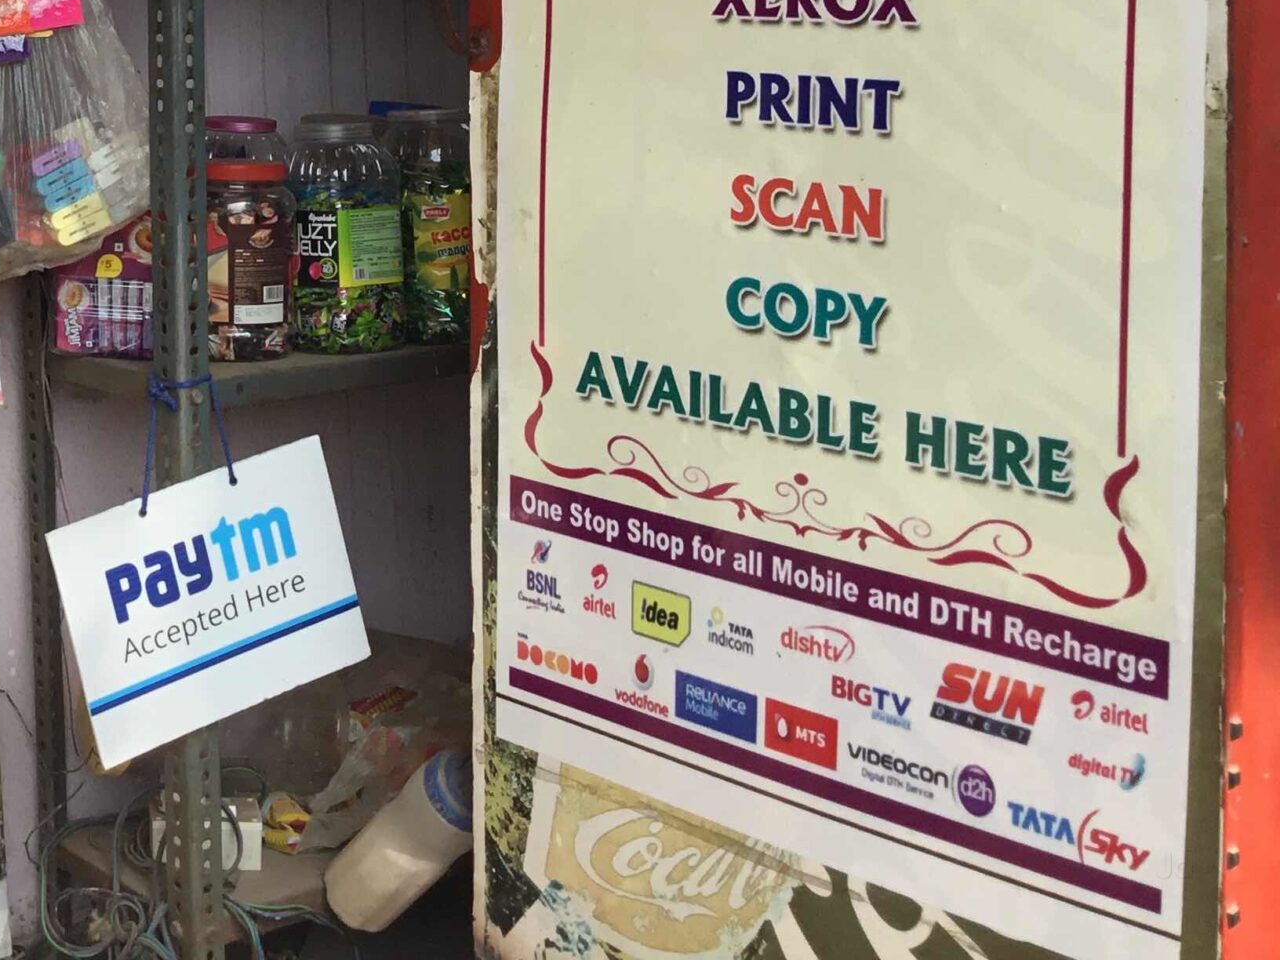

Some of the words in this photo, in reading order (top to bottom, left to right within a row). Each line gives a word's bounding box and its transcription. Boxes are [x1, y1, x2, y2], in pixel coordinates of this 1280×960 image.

[725, 69, 901, 134] PRINT
[728, 172, 887, 242] SCAN
[725, 275, 889, 350] COPY
[573, 350, 880, 458] AVAILABLE
[903, 409, 1074, 498] HERE
[520, 490, 563, 522] One
[569, 501, 620, 542] Stop
[627, 517, 685, 561] Shop
[691, 535, 727, 568] for
[733, 550, 763, 579] all
[771, 555, 859, 603] Mobile
[868, 588, 920, 620] and
[929, 596, 993, 640] DTH
[1003, 615, 1159, 685] Recharge
[526, 569, 562, 601] BSNL
[124, 595, 239, 664] Accepted
[244, 573, 307, 613] Here
[582, 593, 617, 621] airtel
[707, 629, 755, 657] indicom
[727, 622, 754, 640] TATA
[516, 640, 599, 686] DOCOMO
[614, 687, 670, 719] vodafone
[935, 662, 1046, 727] SUN
[794, 725, 827, 748] MTS
[1099, 702, 1150, 736] airtel
[1068, 753, 1117, 782] digital
[959, 775, 994, 804] d2h
[1007, 801, 1076, 846] TATA
